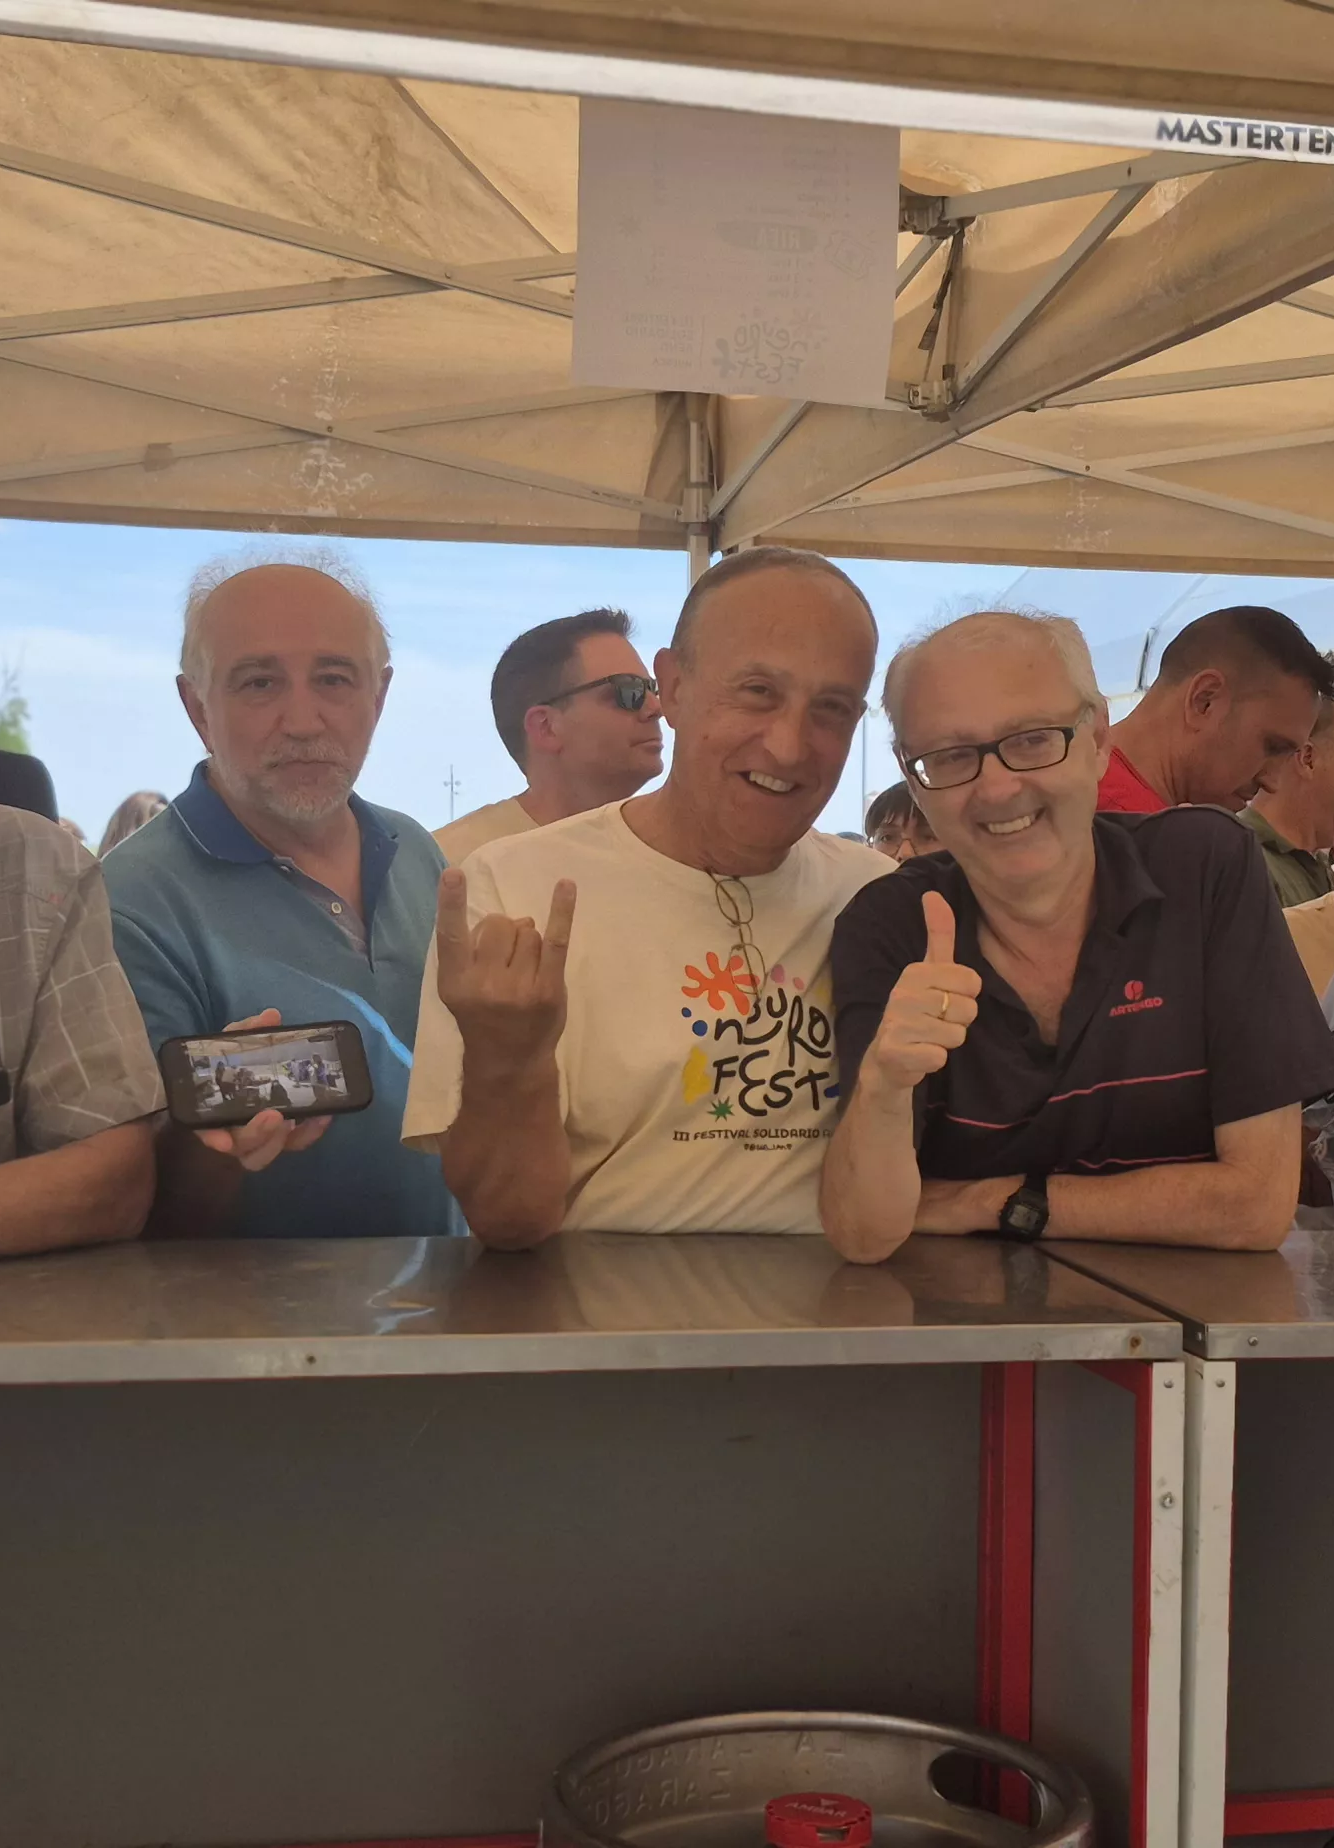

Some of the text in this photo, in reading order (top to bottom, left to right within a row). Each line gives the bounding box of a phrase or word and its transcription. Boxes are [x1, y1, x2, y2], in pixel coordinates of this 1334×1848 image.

[672, 1130, 690, 1142] III
[693, 1129, 751, 1141] FESTIVAL
[753, 1128, 819, 1139] SOLIDARIO
